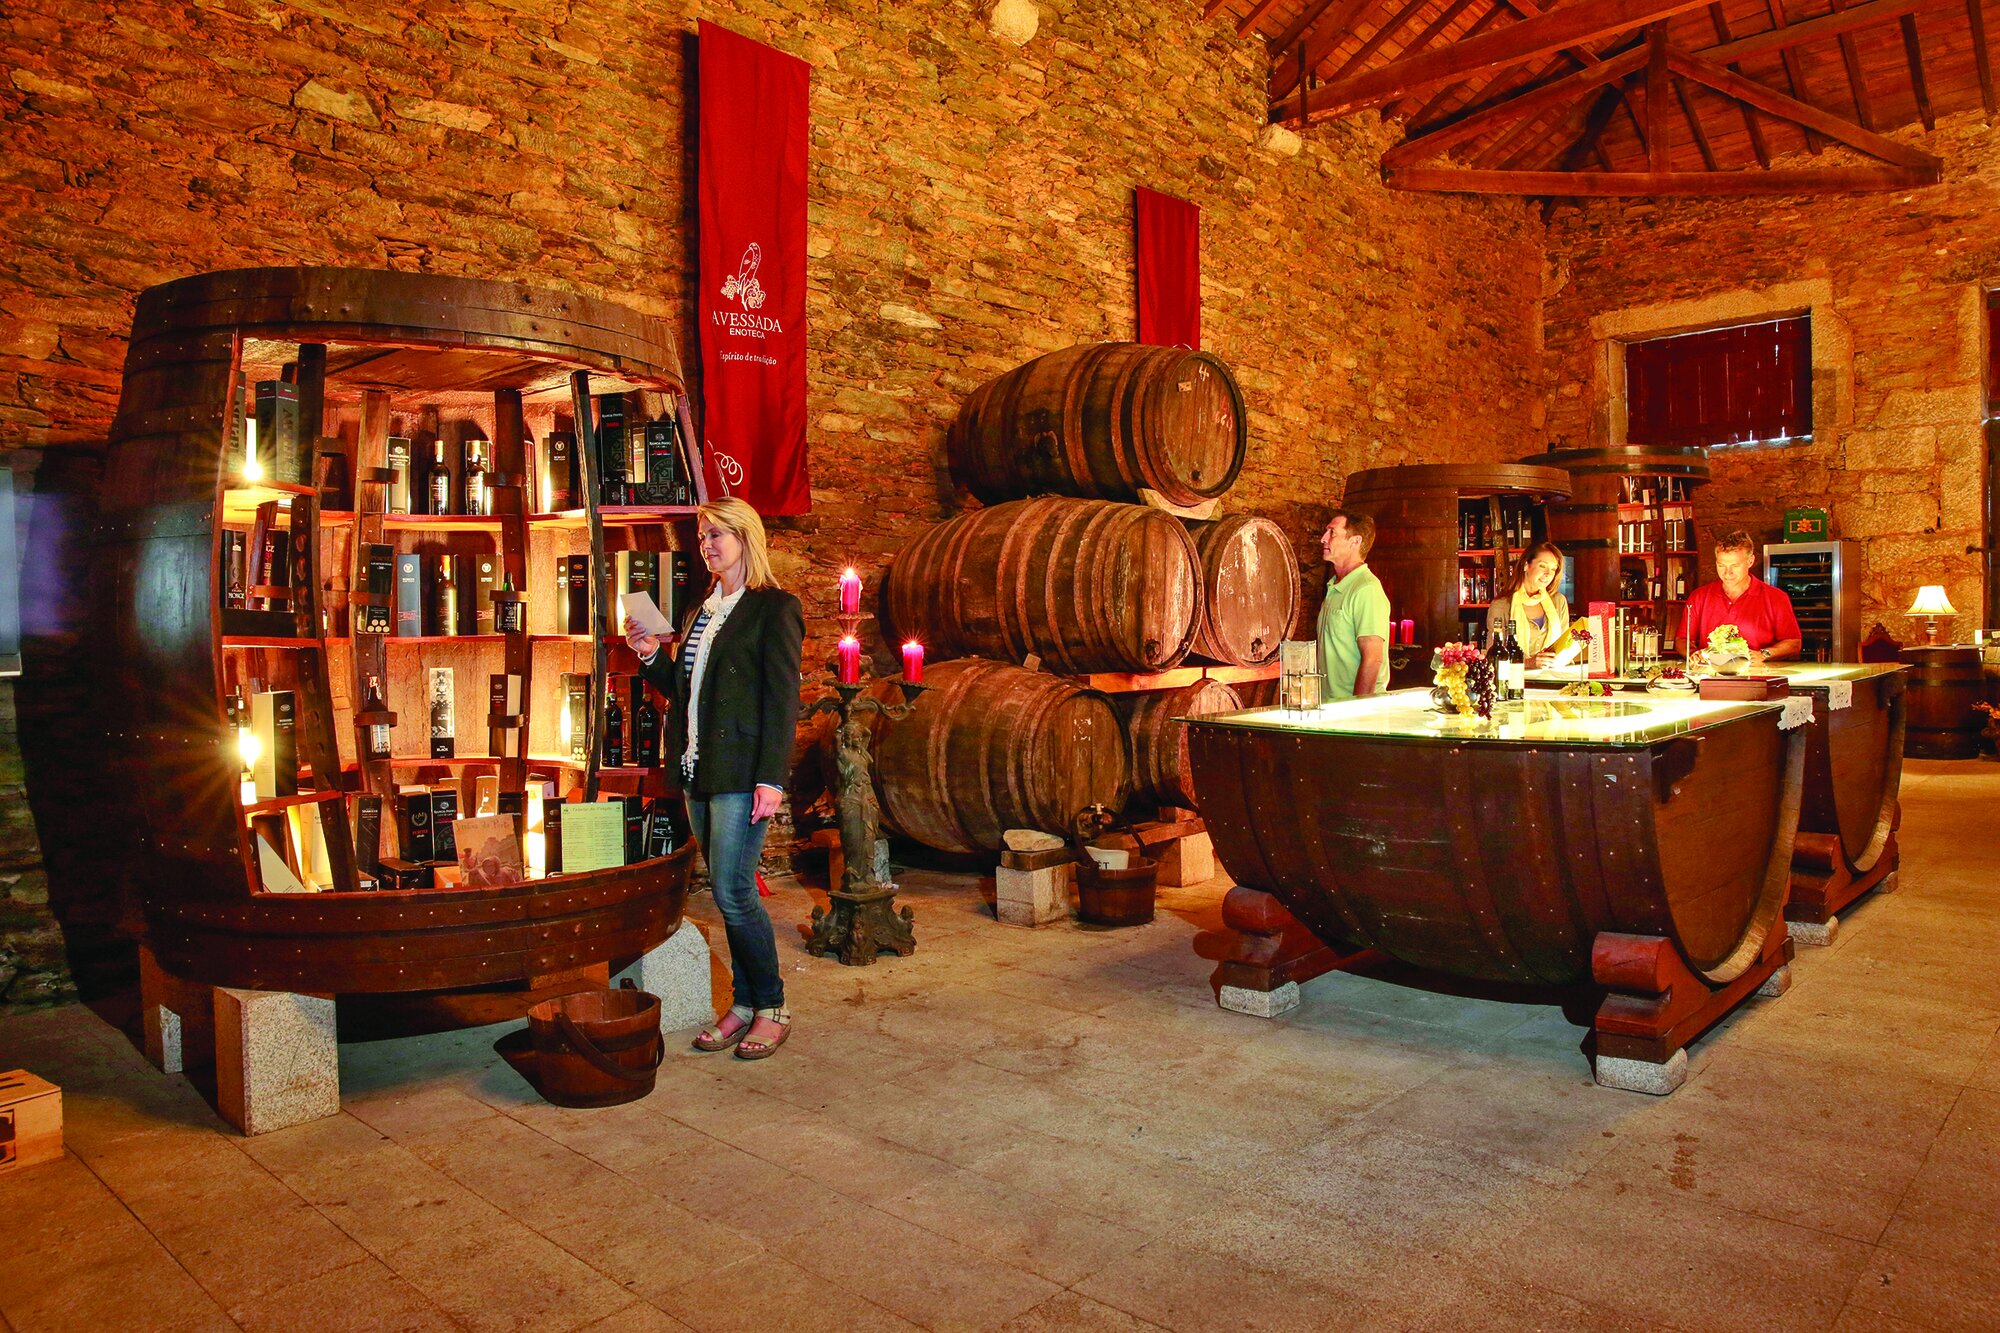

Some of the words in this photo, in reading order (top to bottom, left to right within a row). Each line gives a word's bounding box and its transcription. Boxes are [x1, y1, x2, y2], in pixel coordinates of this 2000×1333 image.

[712, 310, 783, 333] AVESSADA
[729, 327, 766, 339] ENOTECA
[744, 352, 753, 361] de
